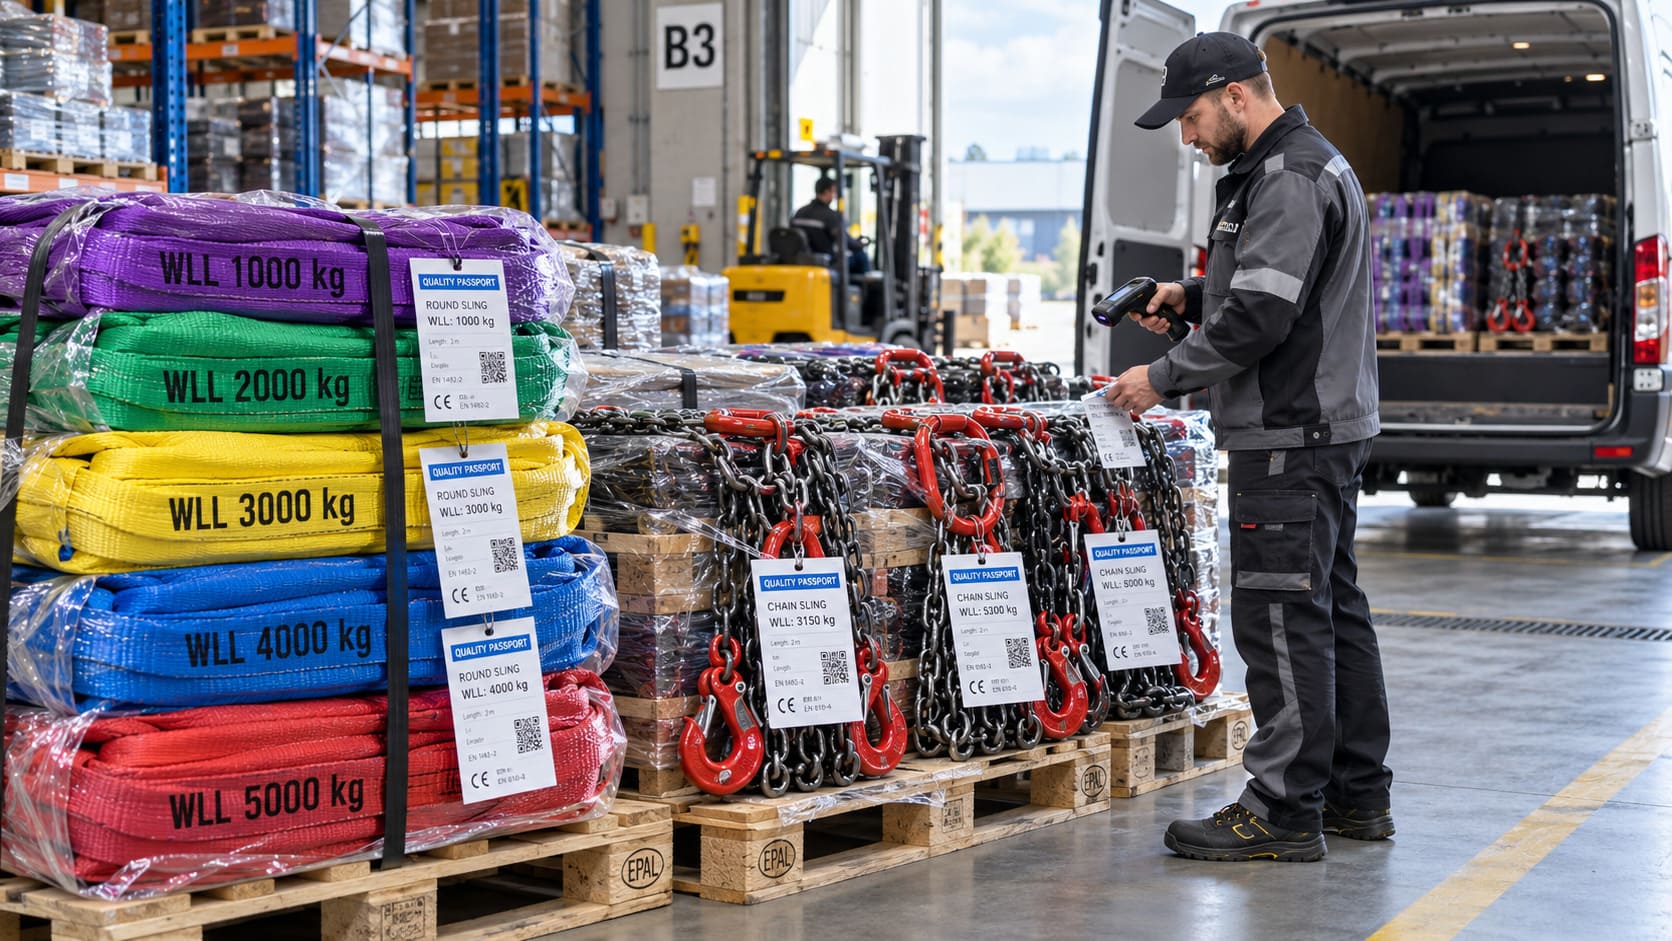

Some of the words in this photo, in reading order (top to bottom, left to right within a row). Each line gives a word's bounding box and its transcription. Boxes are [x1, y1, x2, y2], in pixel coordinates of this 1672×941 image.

[665, 22, 715, 70] B3
[160, 251, 219, 287] WLL
[232, 256, 301, 289] 1000
[312, 258, 345, 298] kg
[422, 277, 455, 287] QUALITY
[457, 278, 496, 287] PASSPORT
[426, 300, 459, 310] ROUND
[461, 300, 488, 310] SLING
[428, 316, 453, 326] WLL:
[456, 315, 480, 326] 1000
[482, 316, 494, 328] kg
[163, 370, 224, 404] WLL
[234, 368, 306, 402] 2000
[318, 367, 350, 407] kg
[432, 466, 462, 477] QUALITY
[464, 462, 501, 474] PASSPORT
[437, 488, 468, 501] ROUND
[470, 486, 495, 498] SLING
[169, 496, 228, 532] WLL
[239, 489, 311, 528] 3000
[322, 487, 355, 526] kg
[439, 506, 464, 518] WLL:
[465, 502, 489, 515] 3000
[490, 501, 503, 514] kg
[1095, 548, 1121, 558] QUALITY
[1121, 545, 1154, 556] PASSPORT
[952, 571, 981, 582] QUALITY
[982, 570, 1017, 579] PASSPORT
[1099, 567, 1124, 577] CHAIN
[1125, 565, 1147, 574] SLING
[764, 578, 796, 589] QUALITY
[798, 576, 837, 586] PASSPORT
[1101, 580, 1122, 590] WLL:
[1123, 578, 1144, 588] 5000
[1144, 578, 1155, 588] kg
[957, 592, 983, 603] CHAIN
[985, 591, 1009, 601] SLING
[767, 601, 797, 612] CHAIN
[799, 600, 827, 610] SLING
[959, 607, 982, 617] WLL:
[983, 605, 1005, 616] 5300
[1006, 605, 1018, 616] kg
[769, 617, 794, 628] WLL:
[796, 615, 821, 626] 3150
[823, 615, 835, 627] kg
[185, 631, 245, 668] WLL
[256, 620, 328, 661] 4000
[339, 618, 371, 658] kg
[454, 644, 487, 658] QUALITY
[488, 638, 528, 652] PASSPORT
[459, 668, 492, 682] ROUND
[494, 663, 520, 677] SLING
[461, 687, 487, 700] WLL:
[489, 681, 514, 695] 4000
[516, 680, 529, 692] kg
[169, 789, 231, 830] WLL
[245, 776, 320, 821] 5000
[331, 774, 364, 813] kg
[763, 846, 791, 872] EPAL
[628, 855, 659, 883] EPAL
